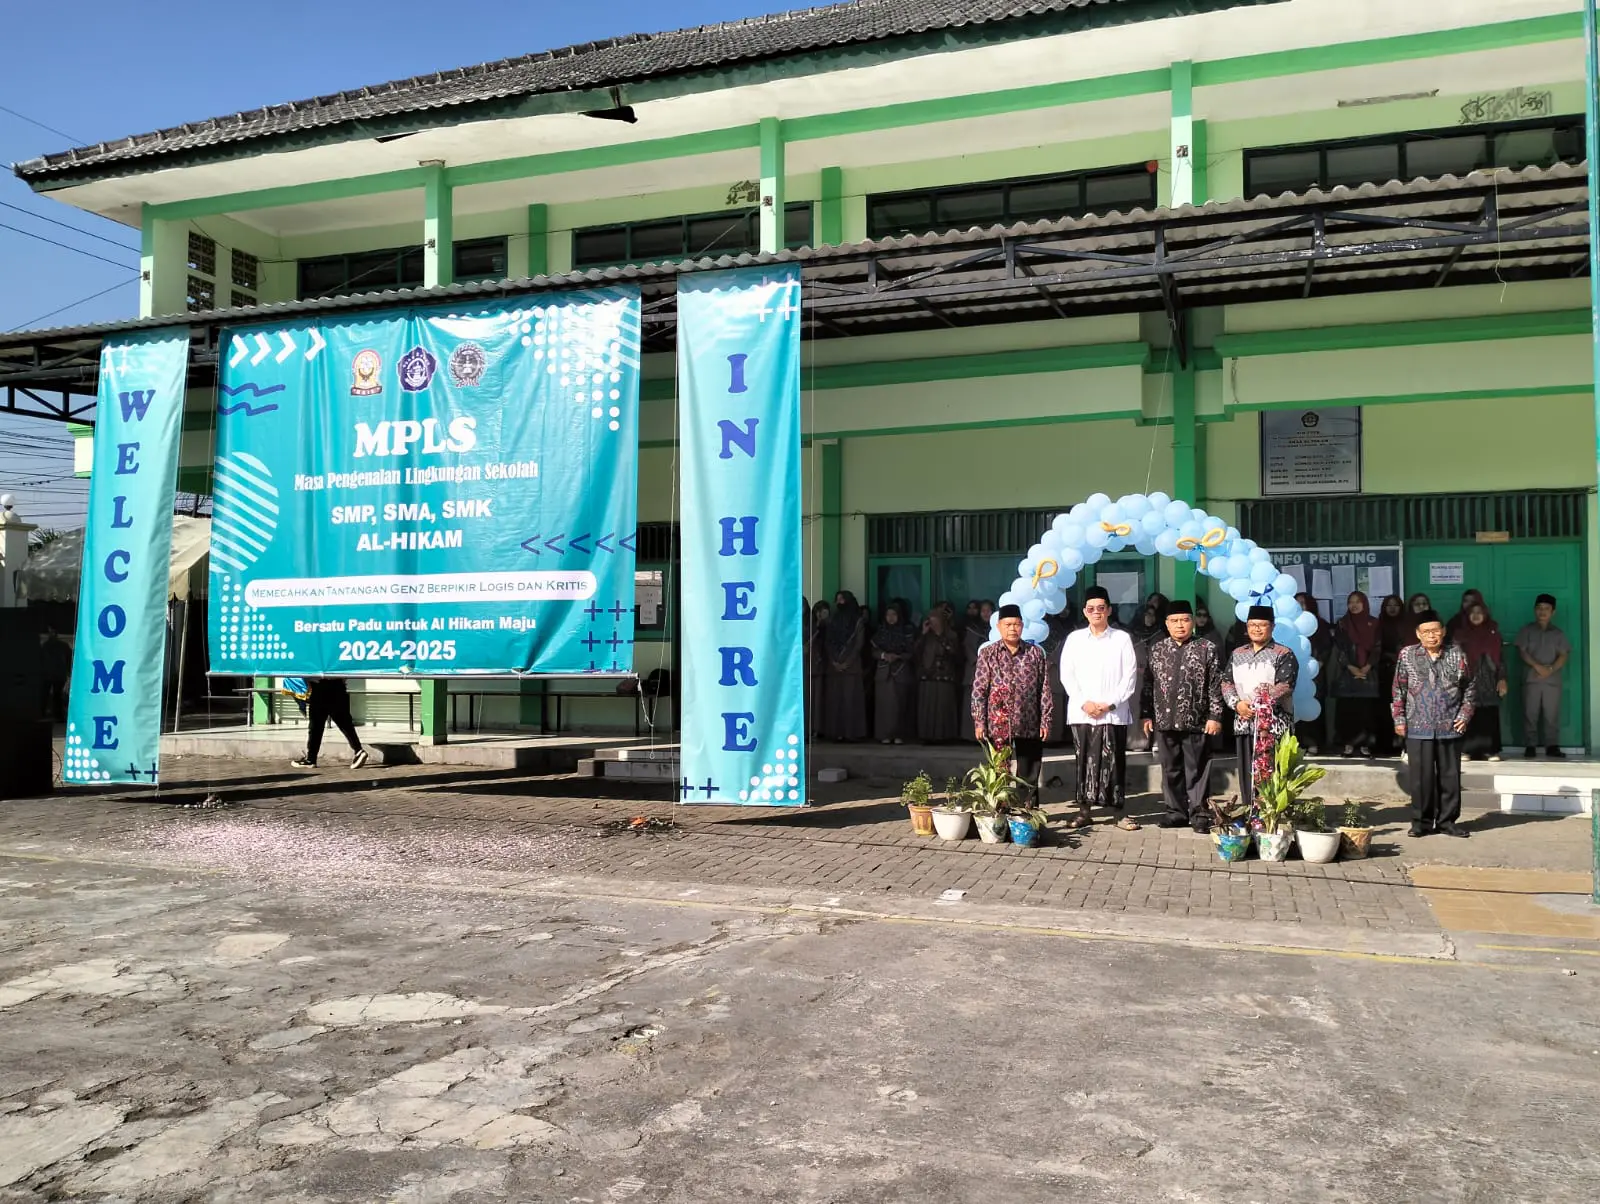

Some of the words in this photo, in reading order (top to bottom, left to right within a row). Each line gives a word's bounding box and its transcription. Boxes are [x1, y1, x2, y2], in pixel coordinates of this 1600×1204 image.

[717, 352, 760, 460] IN
[353, 416, 477, 457] MPLS
[294, 473, 324, 491] Masa
[326, 468, 401, 489] Pengenalan
[405, 464, 481, 486] Lingkungan
[484, 460, 539, 480] Sekolah
[331, 505, 377, 526] SMP,
[383, 502, 437, 524] SMA,
[442, 498, 493, 519] SMK
[356, 529, 463, 552] AL-HIKAM
[91, 388, 156, 751] WELCOME
[1309, 552, 1377, 564] PENTING
[427, 582, 477, 594] BERPIKIR
[479, 580, 514, 592] LOGIS
[546, 579, 588, 591] KRITIS
[294, 619, 345, 633] Bersatu
[348, 618, 382, 631] Padu
[386, 618, 428, 631] untuk
[448, 617, 495, 630] Hikam
[499, 616, 536, 632] Maju
[717, 515, 760, 753] HERE
[338, 639, 457, 661] 2024-2025
